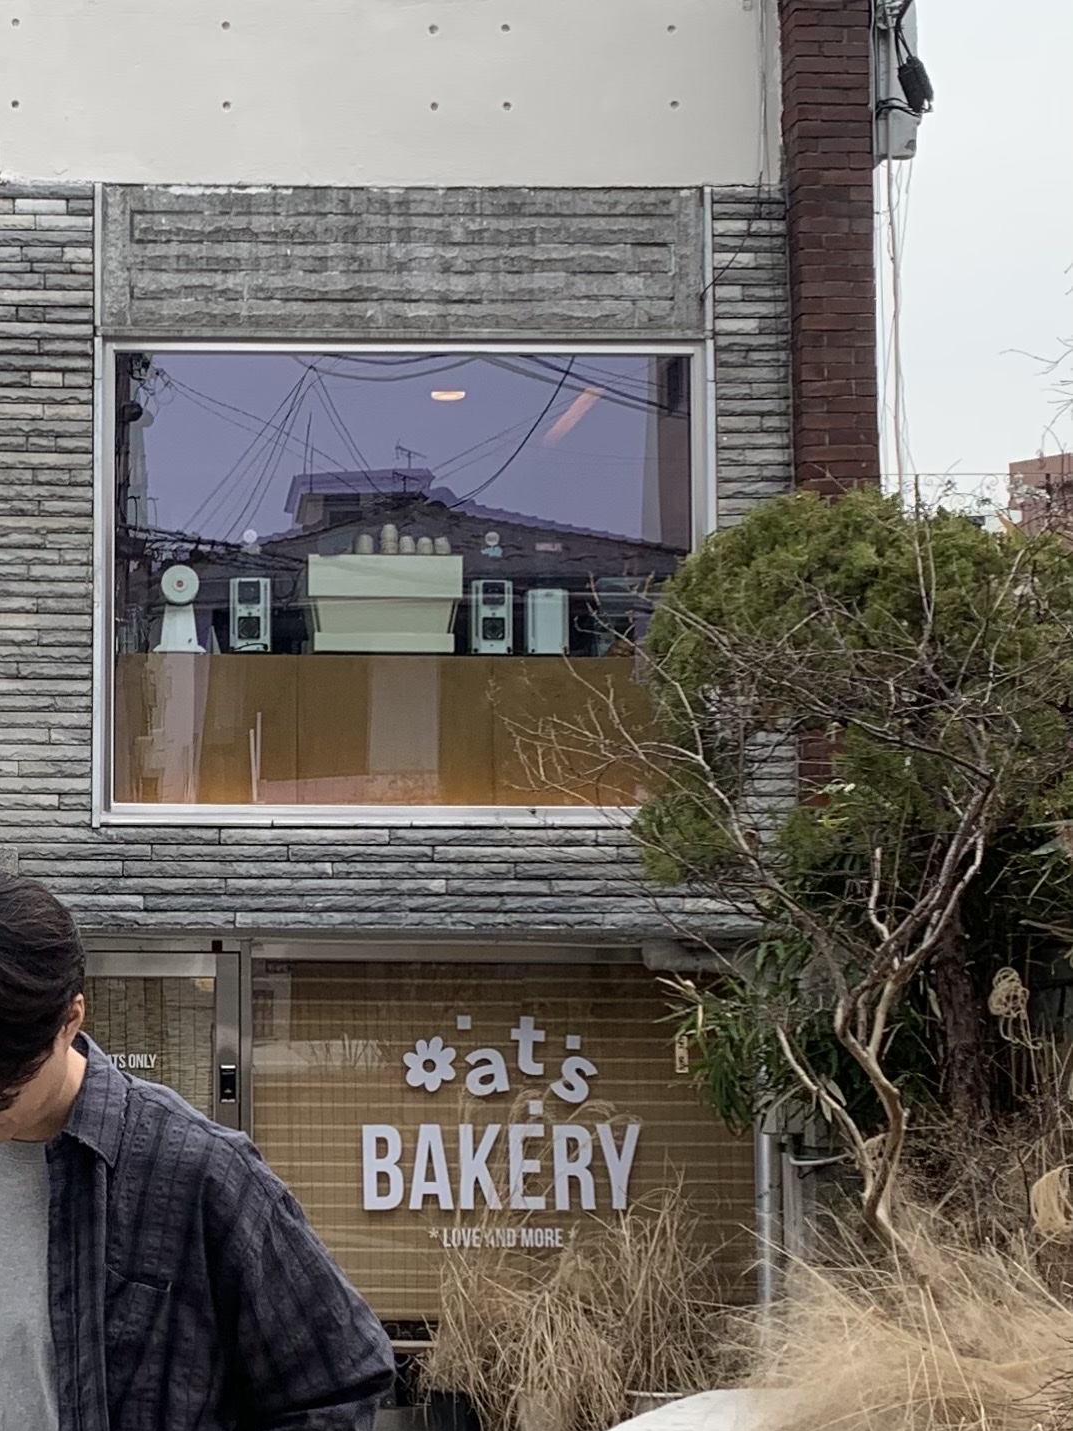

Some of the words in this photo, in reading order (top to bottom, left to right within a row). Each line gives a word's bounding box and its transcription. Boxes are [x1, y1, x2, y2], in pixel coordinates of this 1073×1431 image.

[128, 1053, 157, 1069] ONLY
[361, 1123, 641, 1211] BAKERY
[443, 1227, 481, 1248] LOVE
[484, 1227, 517, 1248] AND
[520, 1227, 564, 1248] MORE
